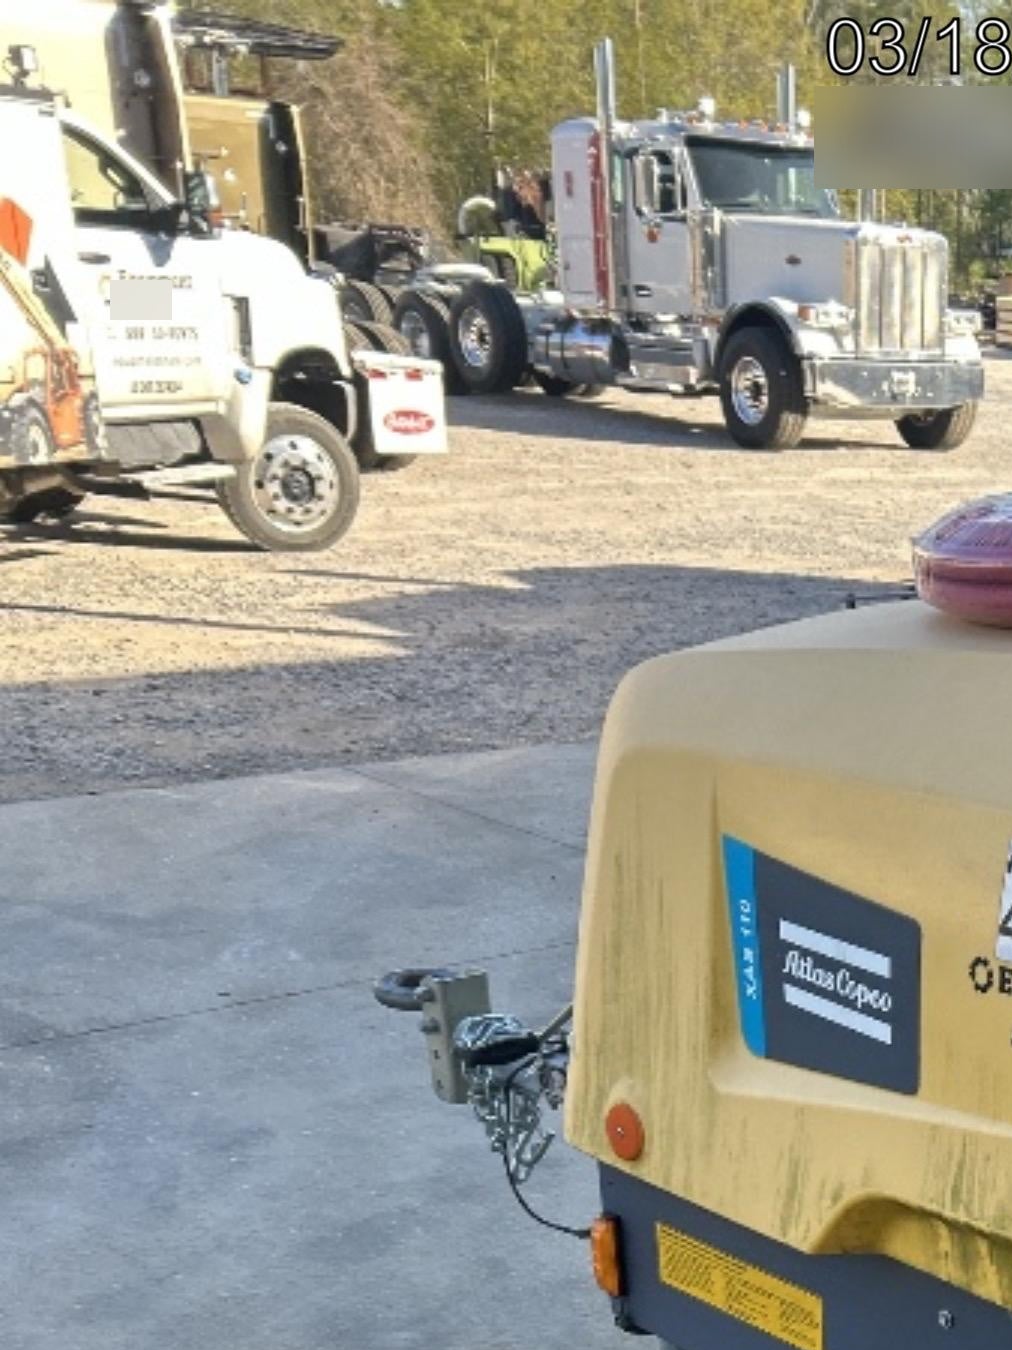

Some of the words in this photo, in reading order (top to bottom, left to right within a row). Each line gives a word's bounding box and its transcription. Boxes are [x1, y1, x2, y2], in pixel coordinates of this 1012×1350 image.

[738, 898, 753, 937] 110
[782, 950, 834, 992] Atlas
[836, 969, 892, 1012] Copco
